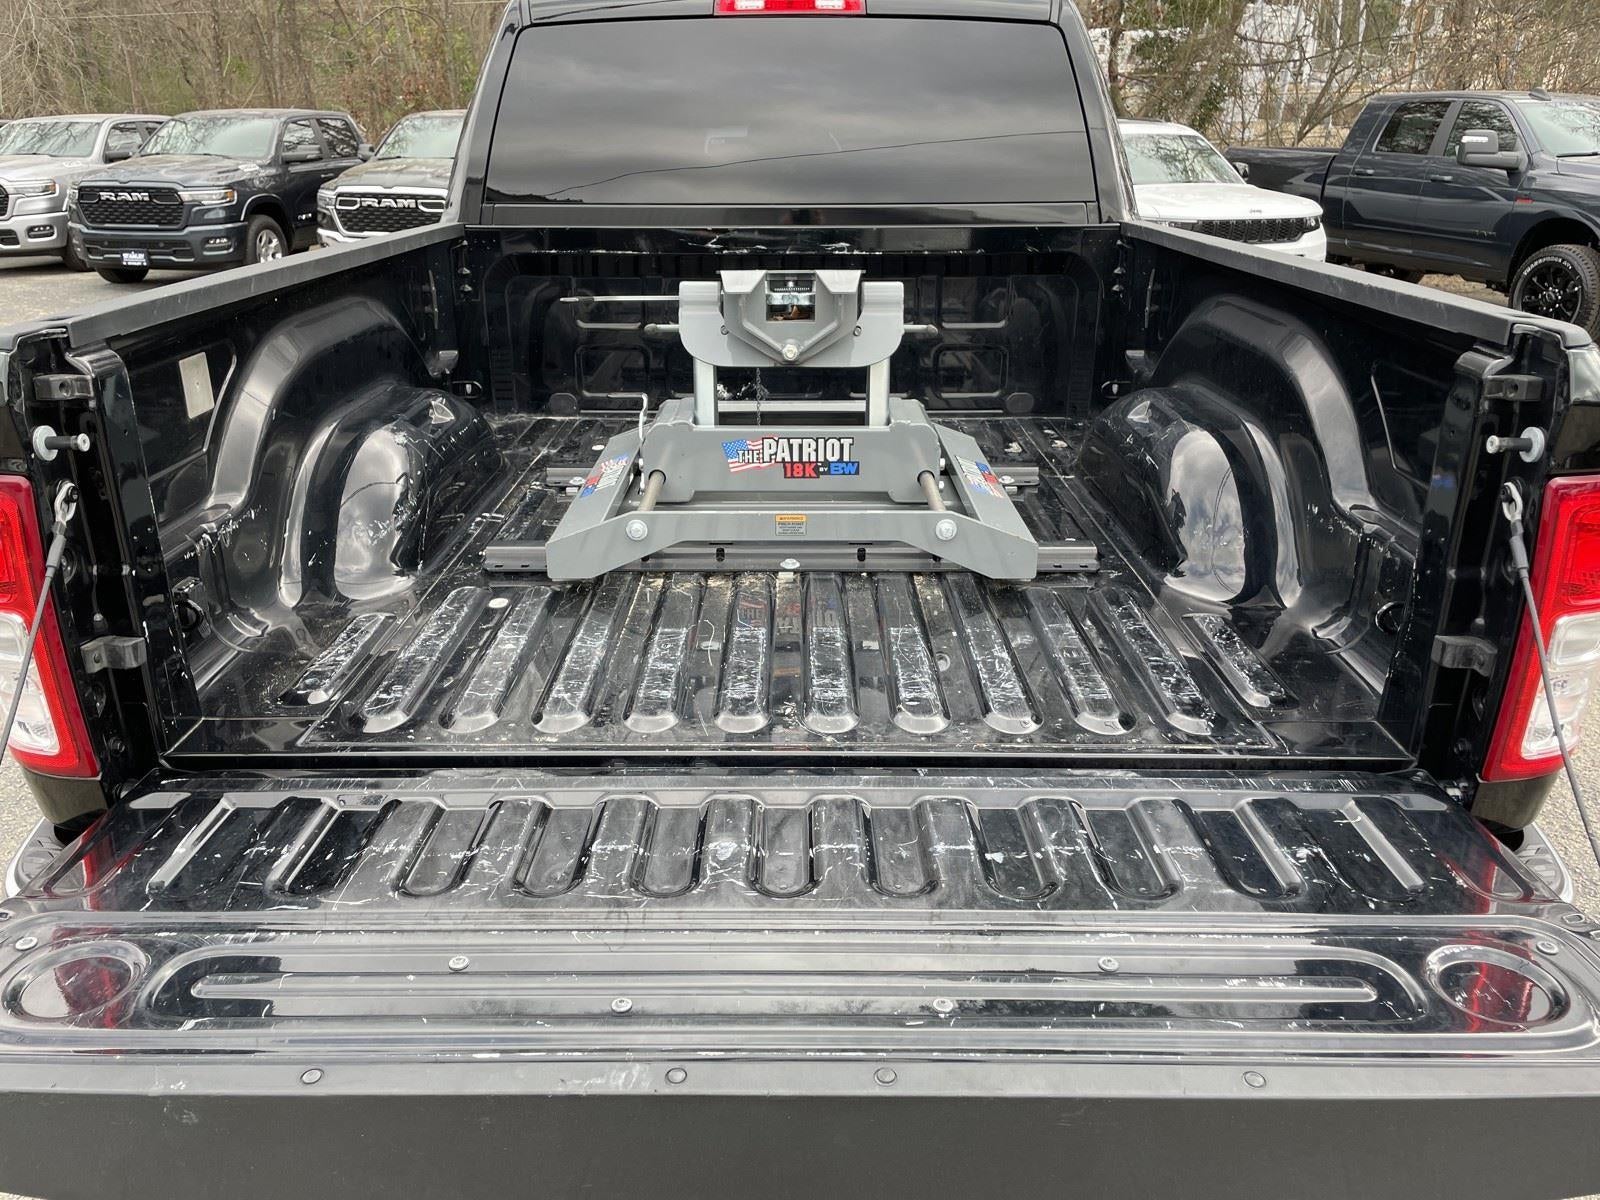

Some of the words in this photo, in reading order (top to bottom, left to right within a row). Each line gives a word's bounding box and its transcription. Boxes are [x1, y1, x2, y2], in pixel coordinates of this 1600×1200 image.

[99, 191, 150, 202] RAM
[361, 198, 416, 208] RAM
[737, 450, 760, 463] THE
[762, 437, 854, 462] PATRIOT
[784, 462, 817, 477] 18K
